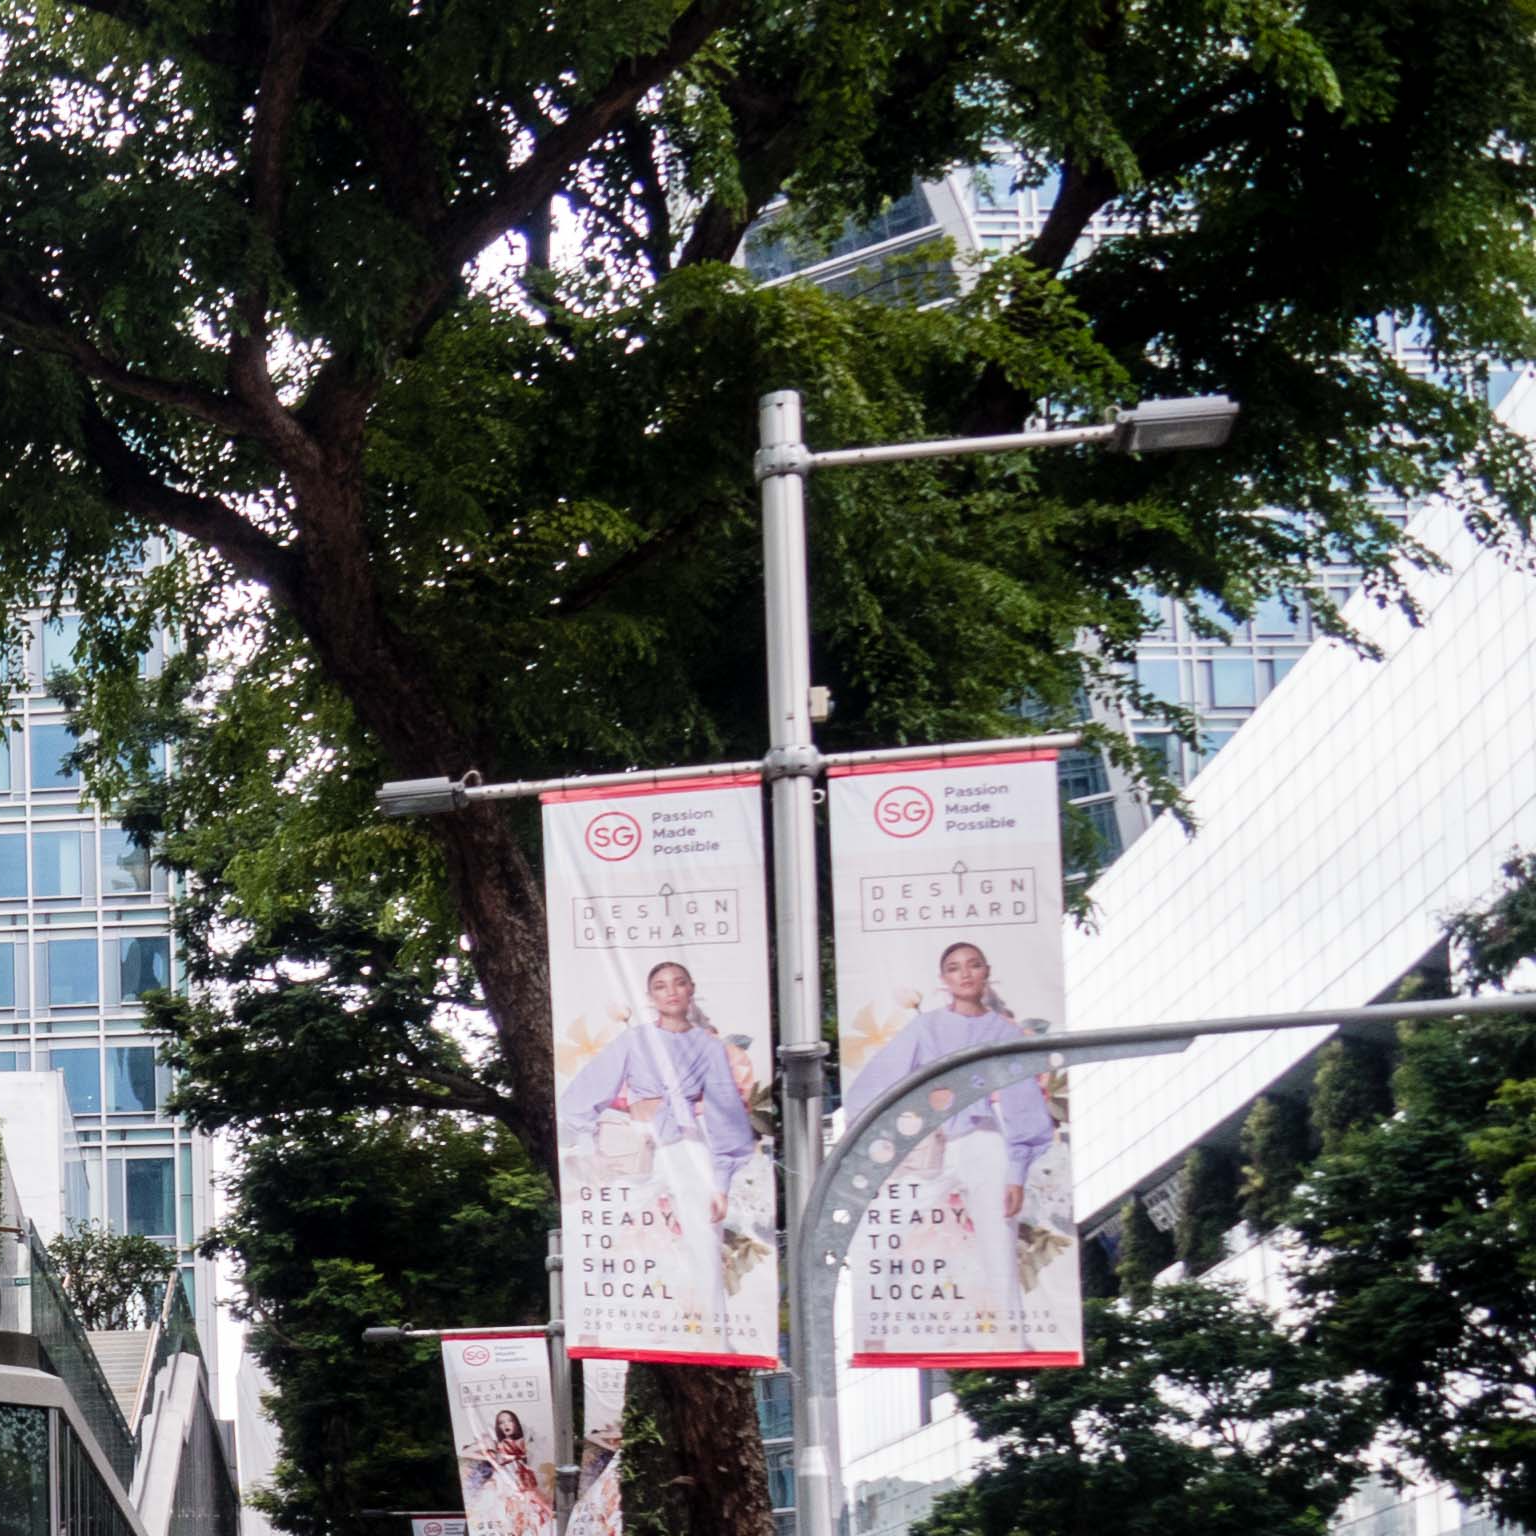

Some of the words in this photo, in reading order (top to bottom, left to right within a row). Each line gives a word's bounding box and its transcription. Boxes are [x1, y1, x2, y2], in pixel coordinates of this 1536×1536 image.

[944, 783, 1009, 798] Passion
[651, 808, 714, 823] Passion
[882, 800, 926, 823] SG
[945, 802, 992, 815] Made
[945, 817, 1016, 832] Possible
[593, 826, 635, 848] SG
[652, 826, 697, 840] Made
[653, 841, 720, 856] Possible
[871, 874, 1025, 901] DESIGN
[583, 894, 729, 920] DESIGN
[872, 901, 1026, 923] ORCHARD
[583, 921, 730, 941] ORCHARD
[580, 1186, 631, 1202] GET
[876, 1183, 920, 1199] ET
[581, 1210, 673, 1226] READY
[868, 1208, 964, 1224] READY
[583, 1233, 613, 1249] TO
[868, 1234, 901, 1249] TO
[583, 1258, 656, 1274] SHOP
[869, 1258, 947, 1275] SHOP
[584, 1281, 673, 1300] LOCAL
[870, 1284, 965, 1300] LOCAL
[583, 1307, 661, 1319] OPENING
[673, 1312, 703, 1321] JAN
[870, 1311, 952, 1321] OPENING
[962, 1311, 997, 1321] JAN
[1008, 1310, 1051, 1321] 2019
[583, 1321, 614, 1331] 250
[623, 1322, 703, 1335] ORCHARD
[714, 1327, 758, 1338] ROAD
[870, 1325, 900, 1335] 250
[911, 1324, 998, 1335] ORCHARD
[1009, 1323, 1057, 1334] ROAD
[466, 1350, 488, 1361] SG
